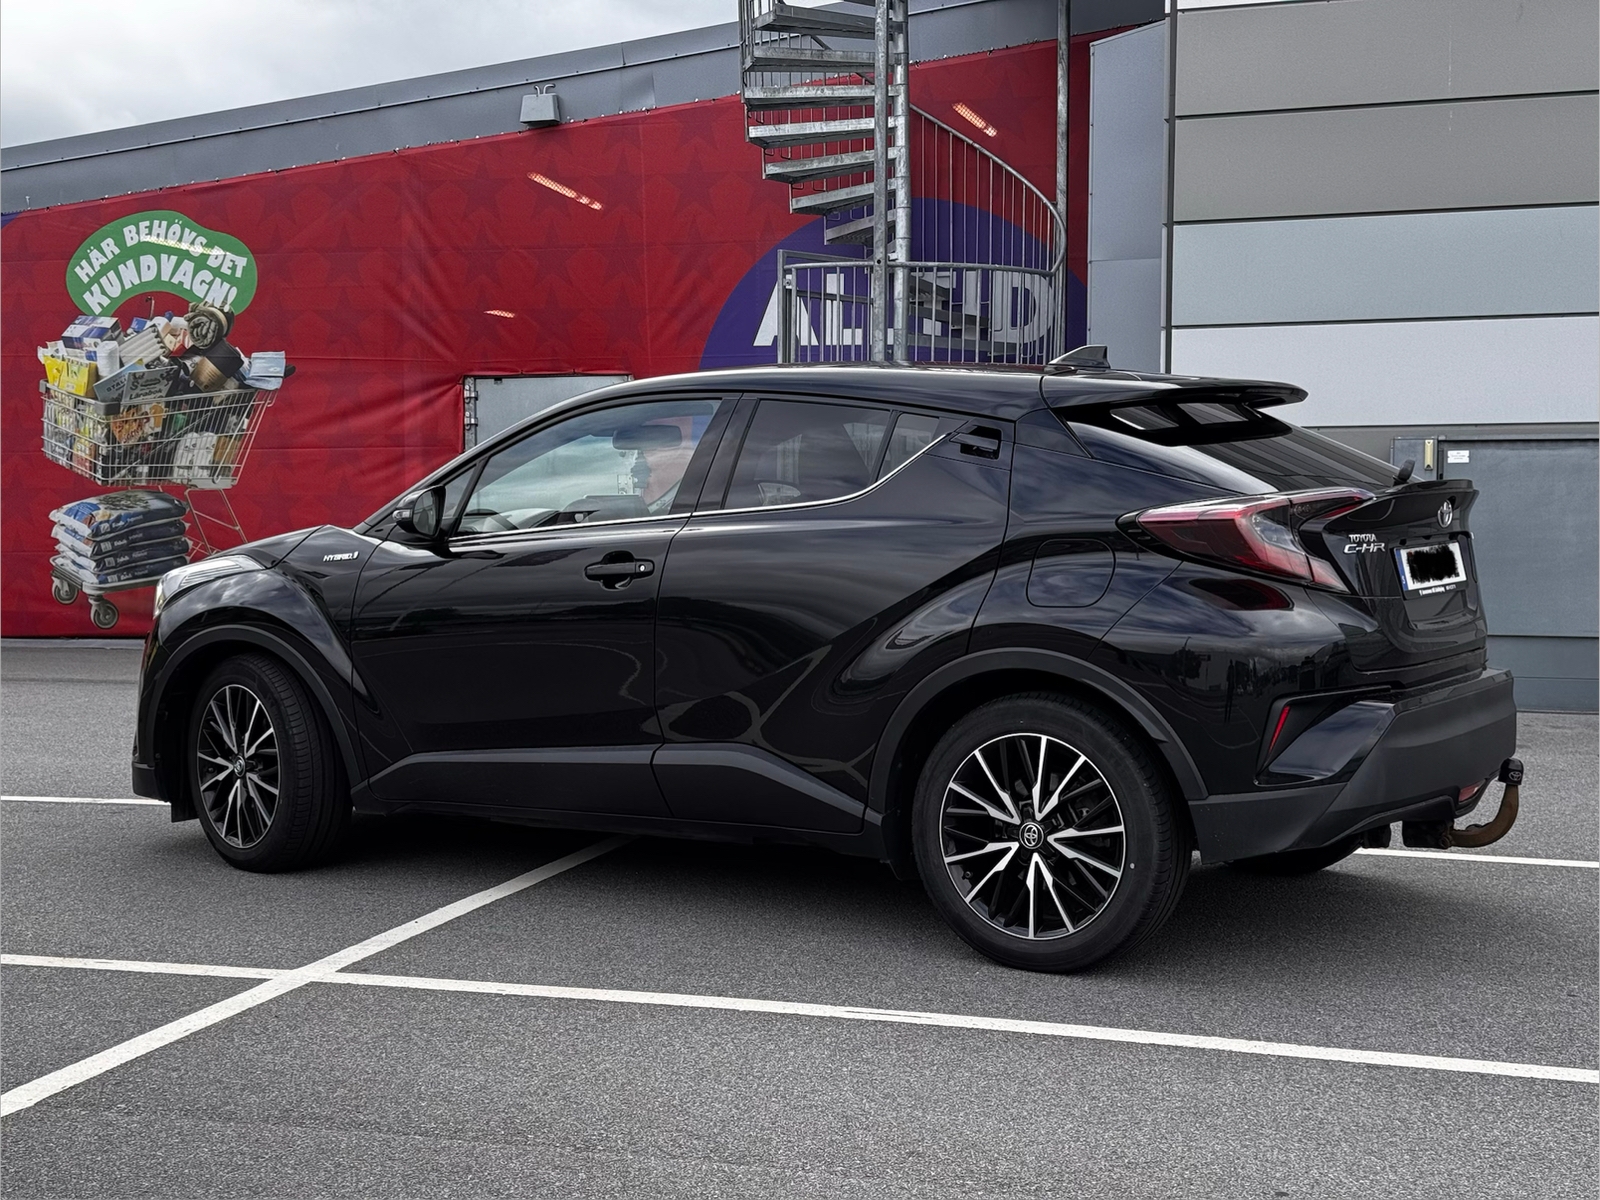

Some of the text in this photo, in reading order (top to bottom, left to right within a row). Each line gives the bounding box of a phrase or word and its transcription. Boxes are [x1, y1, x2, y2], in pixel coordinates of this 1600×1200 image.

[74, 219, 247, 284] HÄR BEHÖVS DET
[82, 253, 238, 315] KUNDVAGN!
[1343, 542, 1386, 554] C-HR
[1349, 533, 1377, 543] TOYOTA
